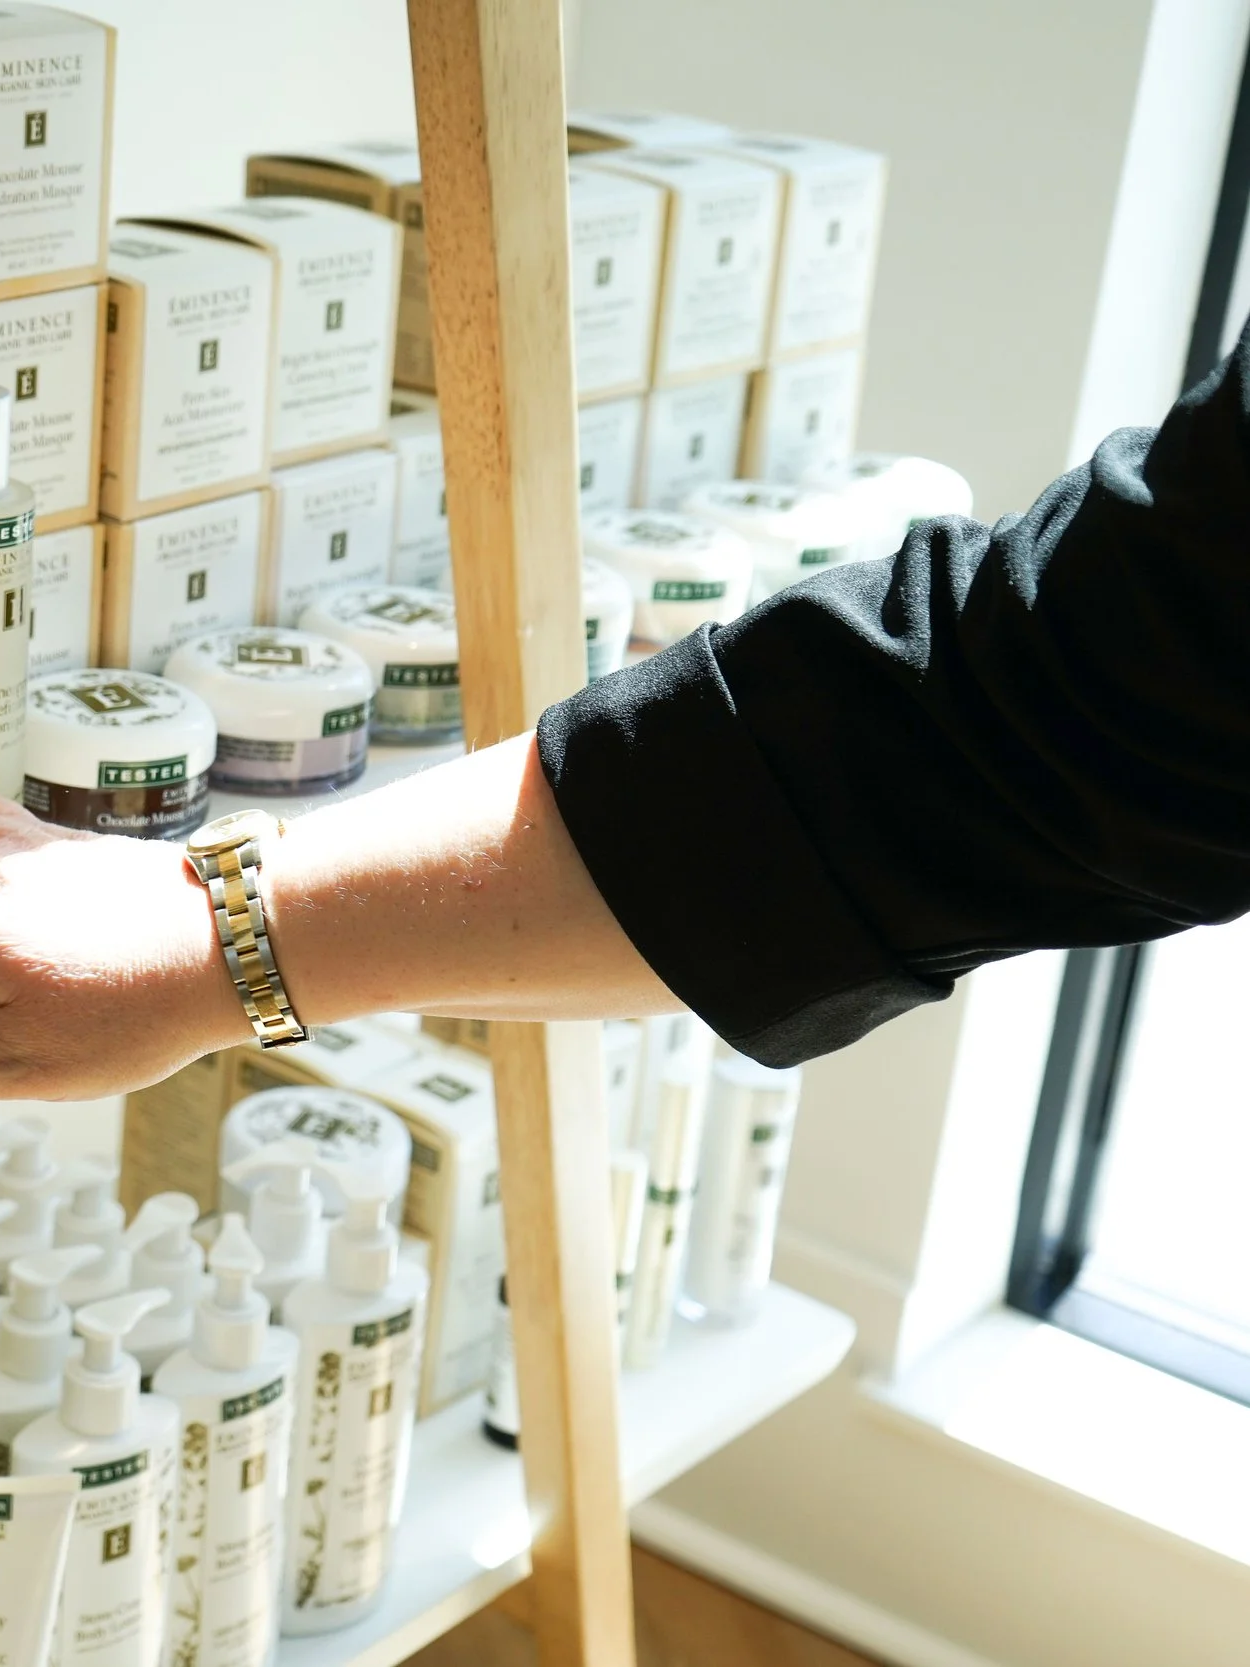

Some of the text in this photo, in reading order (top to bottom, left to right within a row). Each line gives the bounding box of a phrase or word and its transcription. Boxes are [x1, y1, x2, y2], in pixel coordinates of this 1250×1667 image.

[42, 163, 84, 178] Mousse
[41, 182, 85, 200] Masque
[86, 684, 130, 710] É
[107, 763, 183, 783] TESTER
[96, 812, 150, 828] Chocolate
